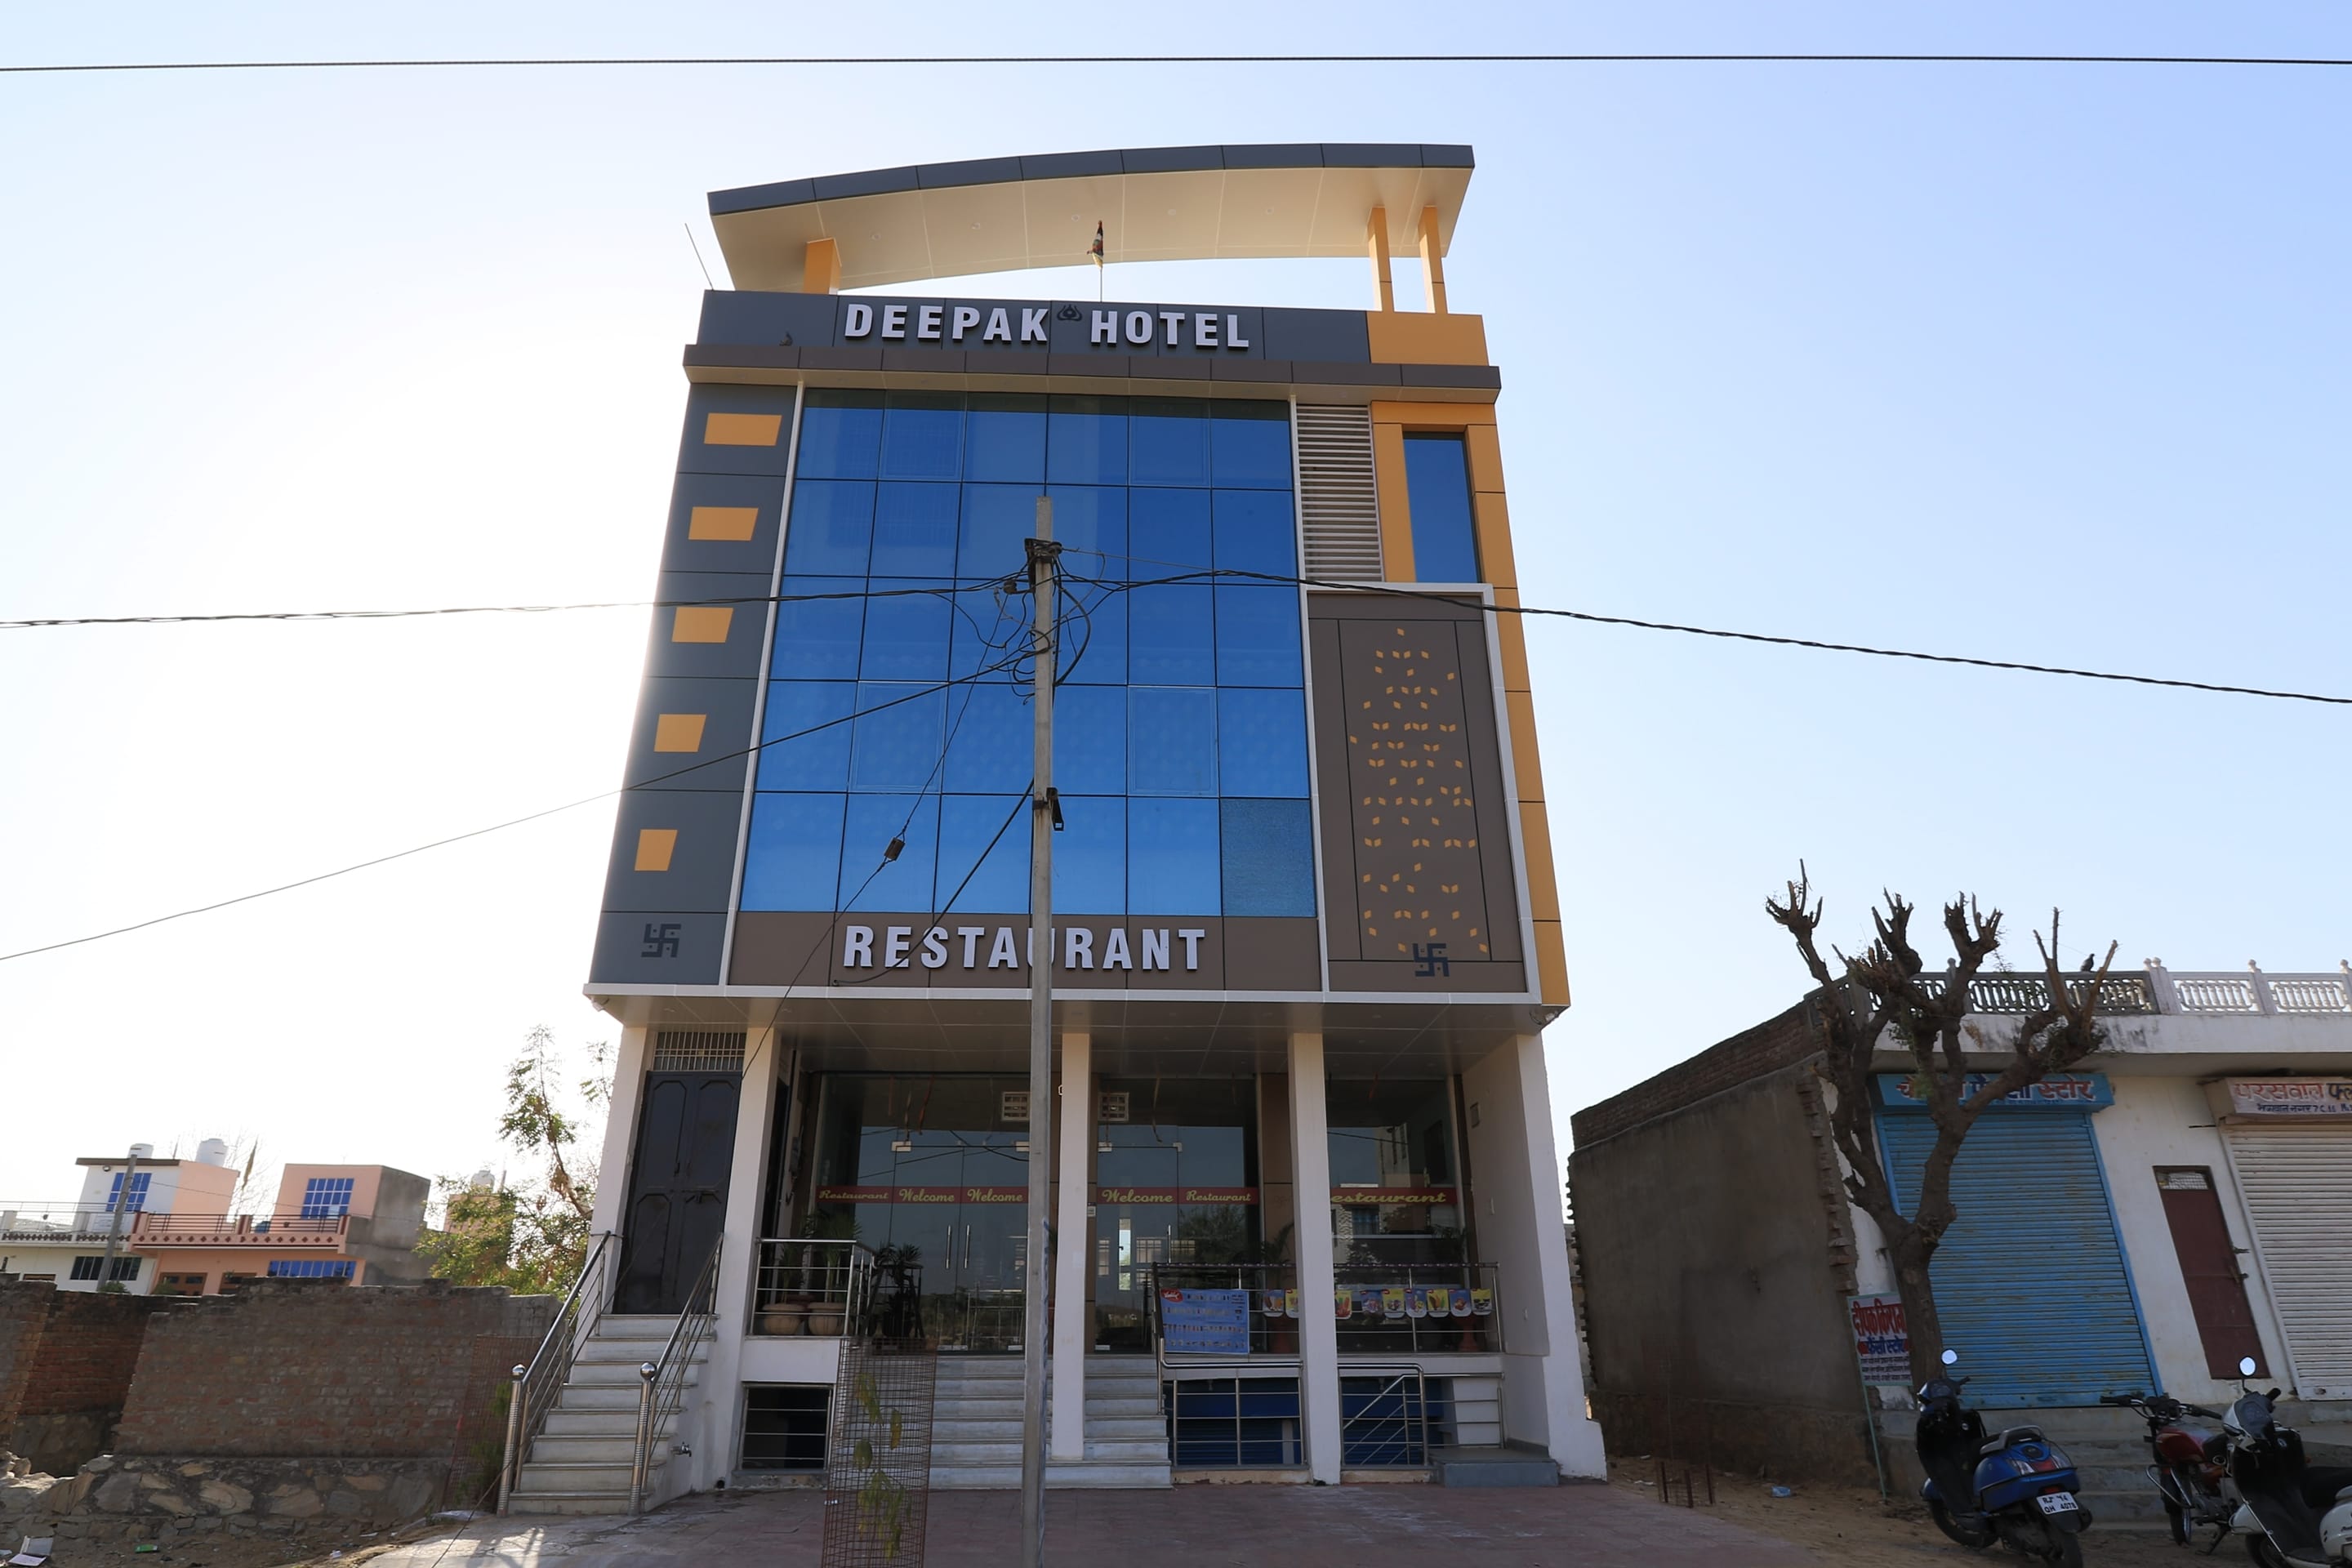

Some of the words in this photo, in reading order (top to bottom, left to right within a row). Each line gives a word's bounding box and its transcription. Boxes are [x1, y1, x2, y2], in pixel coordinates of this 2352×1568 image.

[844, 303, 1049, 342] DEEPAK
[1090, 310, 1249, 348] HOTEL
[819, 1190, 889, 1200] Restaurant
[899, 1189, 955, 1202] Welcome
[967, 1189, 1023, 1202] Welcome
[1102, 1189, 1174, 1203] Welcome
[1186, 1191, 1251, 1201] Restaurant
[1331, 1192, 1446, 1203] estaurant
